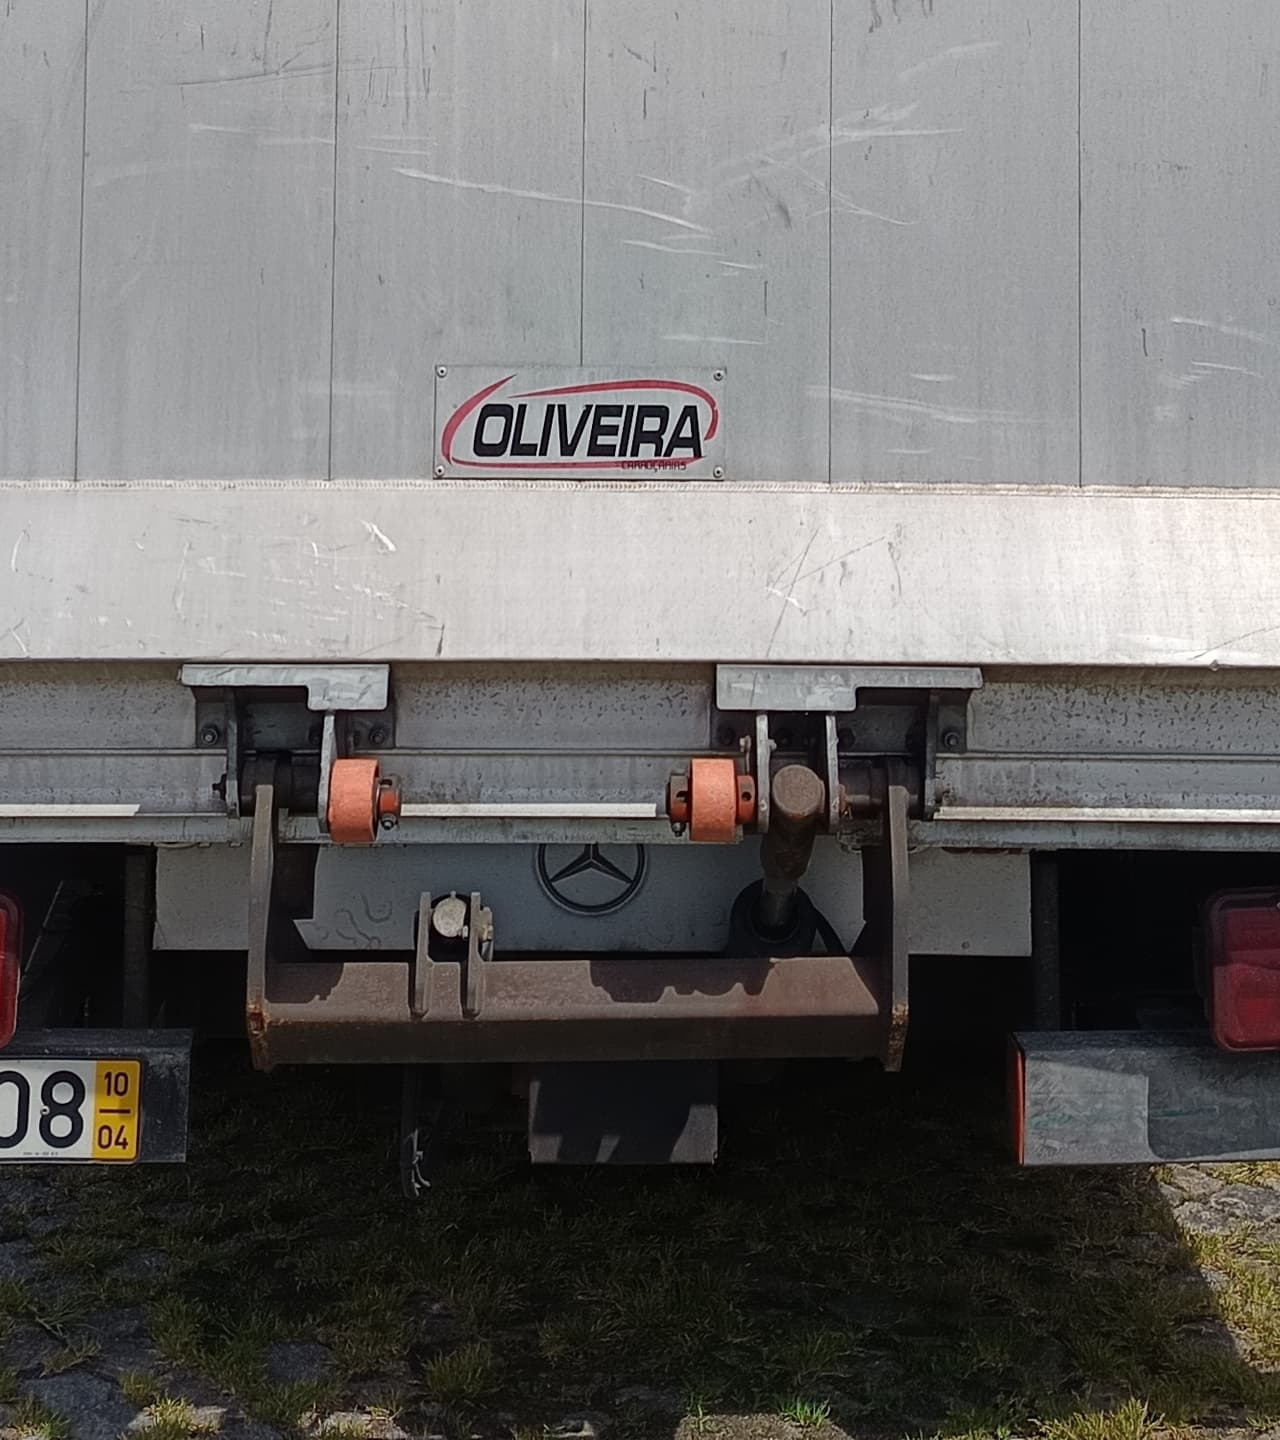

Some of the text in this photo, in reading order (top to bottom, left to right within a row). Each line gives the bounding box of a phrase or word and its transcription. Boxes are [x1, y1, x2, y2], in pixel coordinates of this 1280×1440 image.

[472, 403, 702, 458] OLIVEIRA
[104, 1071, 129, 1097] 10
[97, 1124, 129, 1150] 04
